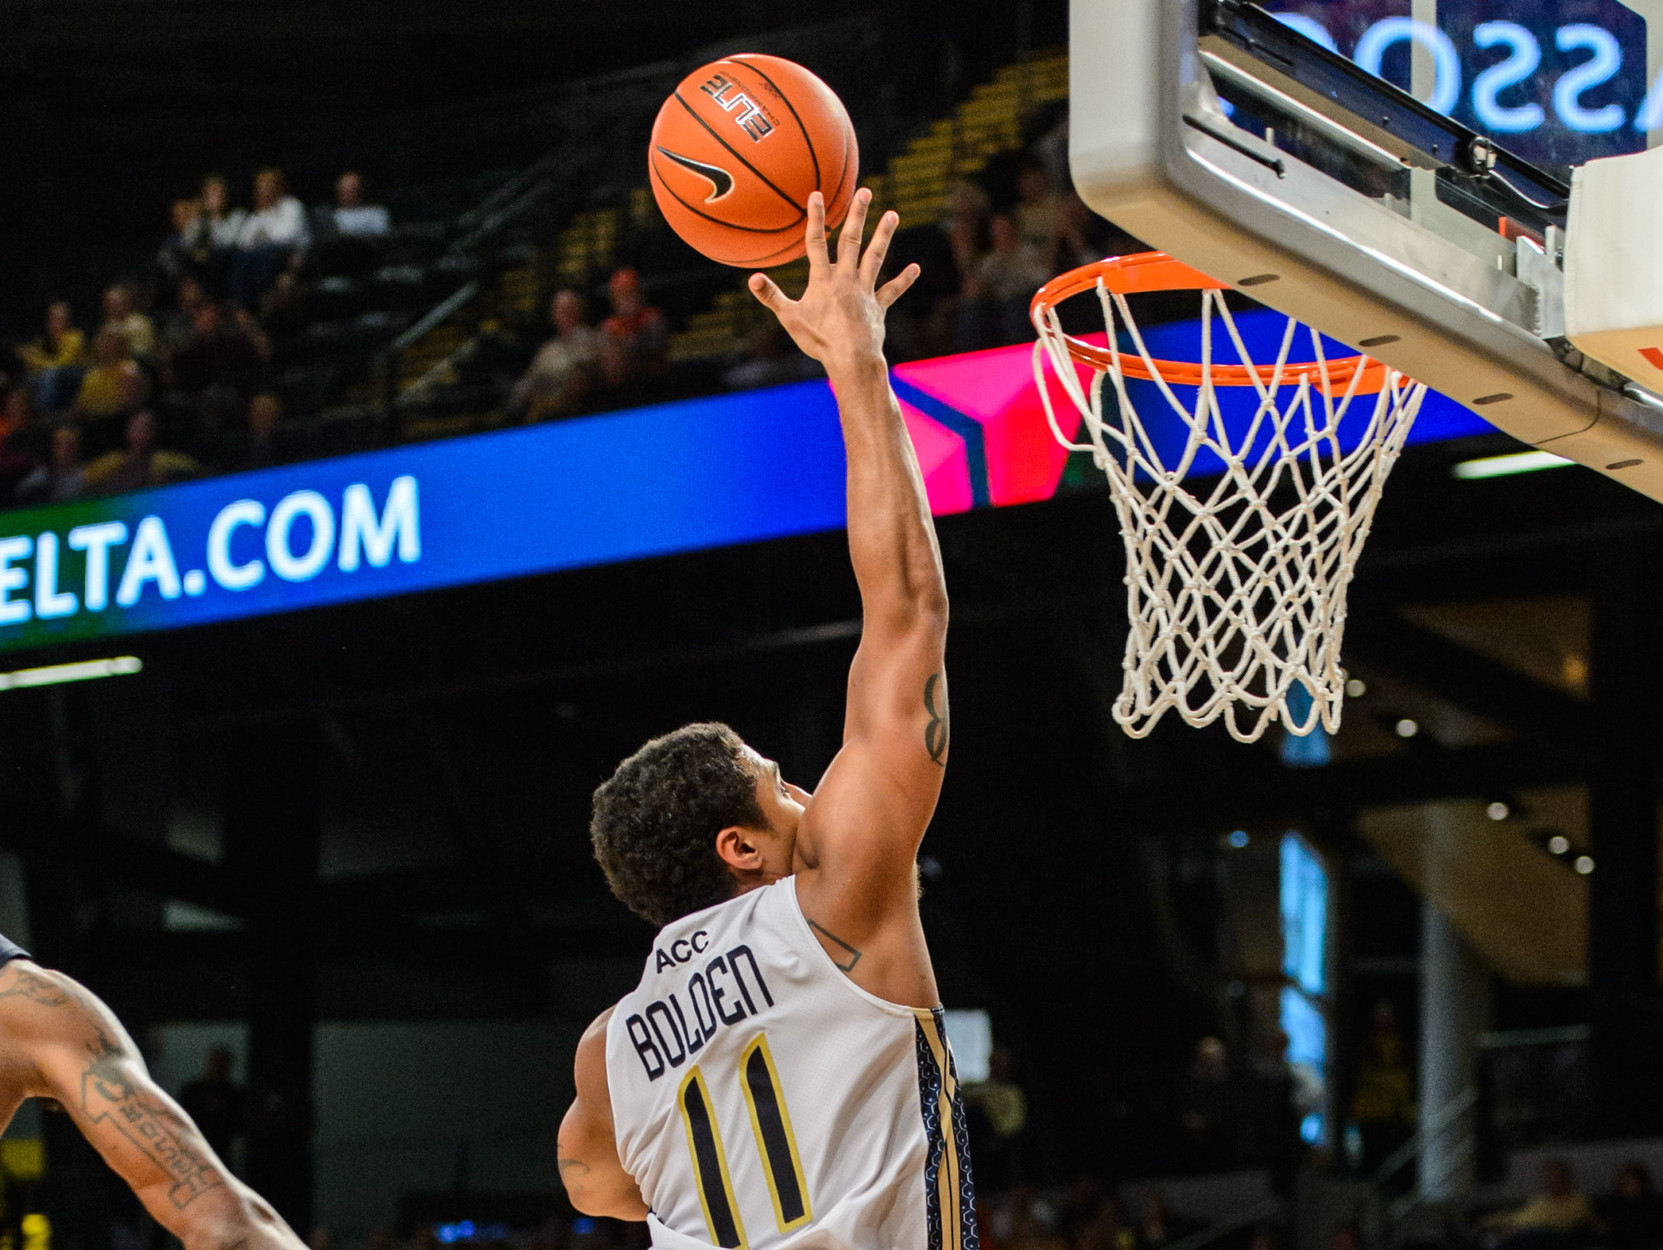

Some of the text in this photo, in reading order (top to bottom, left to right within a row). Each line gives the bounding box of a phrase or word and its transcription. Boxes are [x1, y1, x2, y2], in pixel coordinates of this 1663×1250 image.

[700, 74, 775, 143] ELITE
[0, 474, 422, 627] ELTA.COM
[625, 944, 775, 1082] BOLDEN
[655, 930, 709, 974] ACC
[677, 1031, 814, 1250] 11
